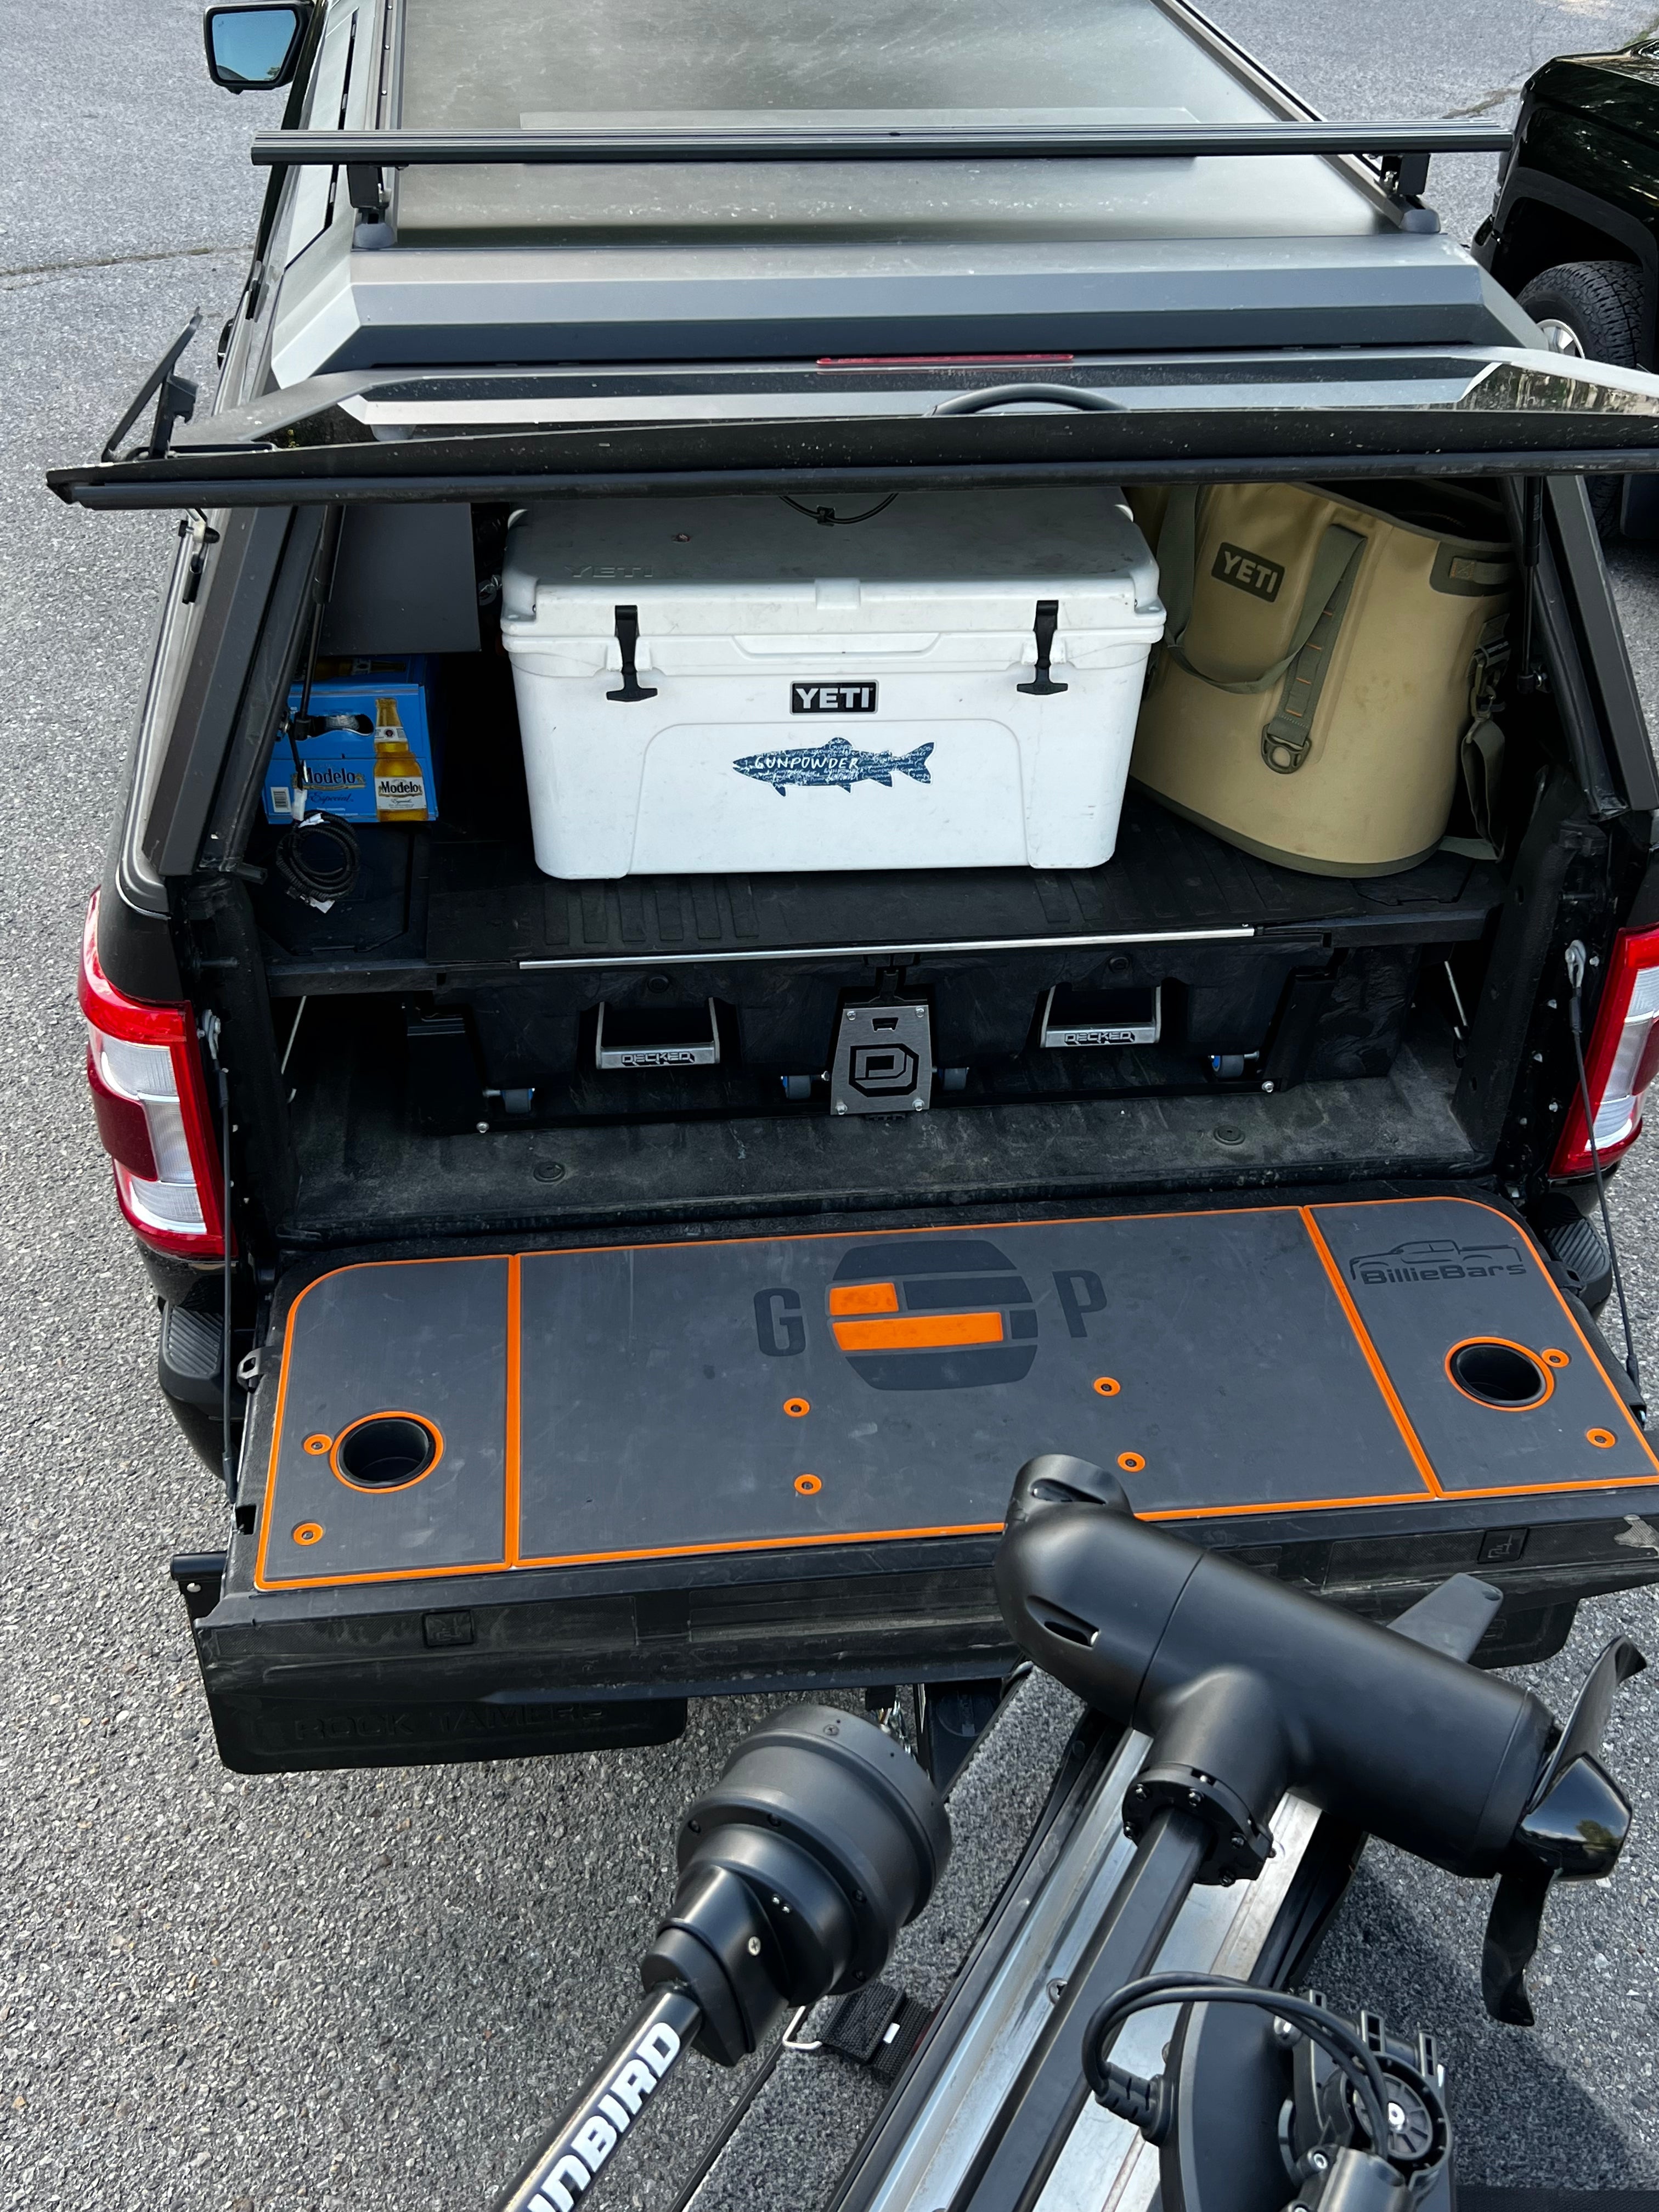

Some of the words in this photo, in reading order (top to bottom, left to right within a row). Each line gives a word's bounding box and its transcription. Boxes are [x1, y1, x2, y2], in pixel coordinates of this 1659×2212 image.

[563, 566, 653, 578] YETI
[1223, 550, 1278, 594] YETI
[795, 687, 870, 709] YETI
[754, 756, 859, 769] GUNPOWDER
[381, 781, 419, 793] Modelo
[1064, 1031, 1136, 1045] DECKED
[621, 1051, 696, 1066] DECKED
[1361, 1263, 1527, 1284] BillieBars
[753, 1287, 806, 1357] G
[1051, 1269, 1107, 1338] P
